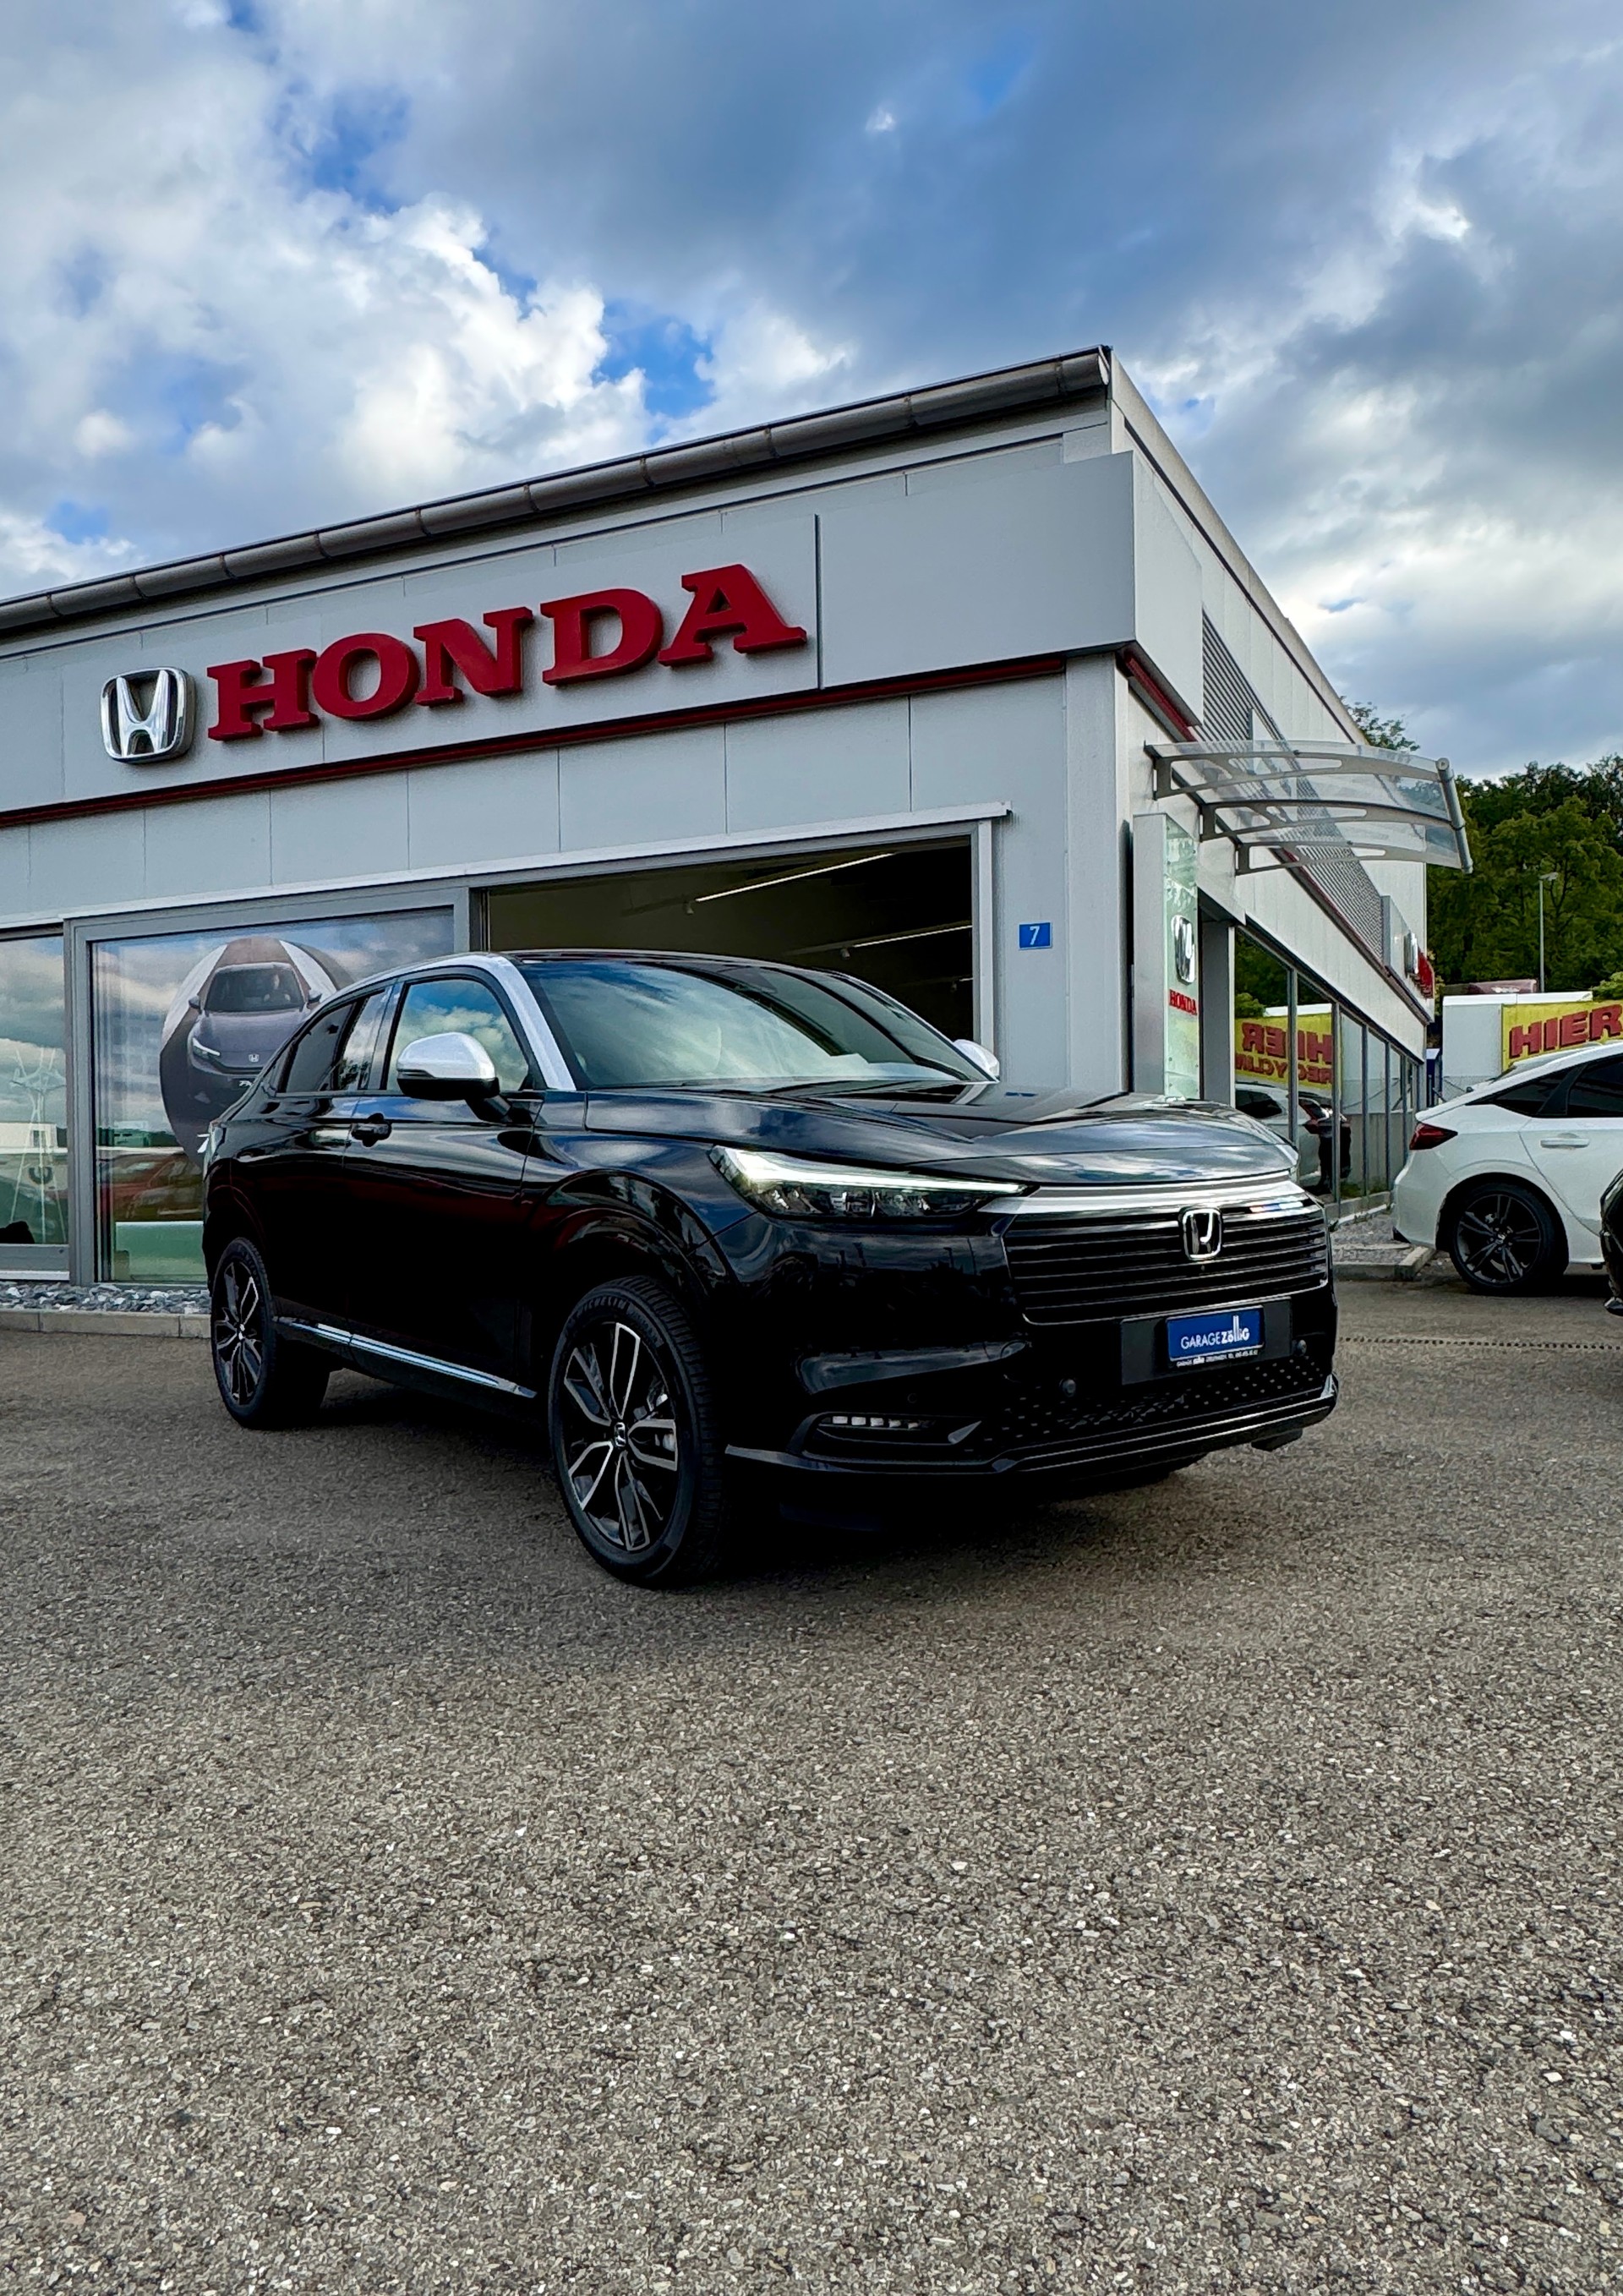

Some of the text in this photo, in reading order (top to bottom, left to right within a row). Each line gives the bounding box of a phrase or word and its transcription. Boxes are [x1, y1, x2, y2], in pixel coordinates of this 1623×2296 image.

[207, 564, 807, 741] HONDA
[1030, 926, 1040, 945] 7
[1169, 988, 1198, 1016] HONDA
[1509, 1003, 1623, 1059] HIER
